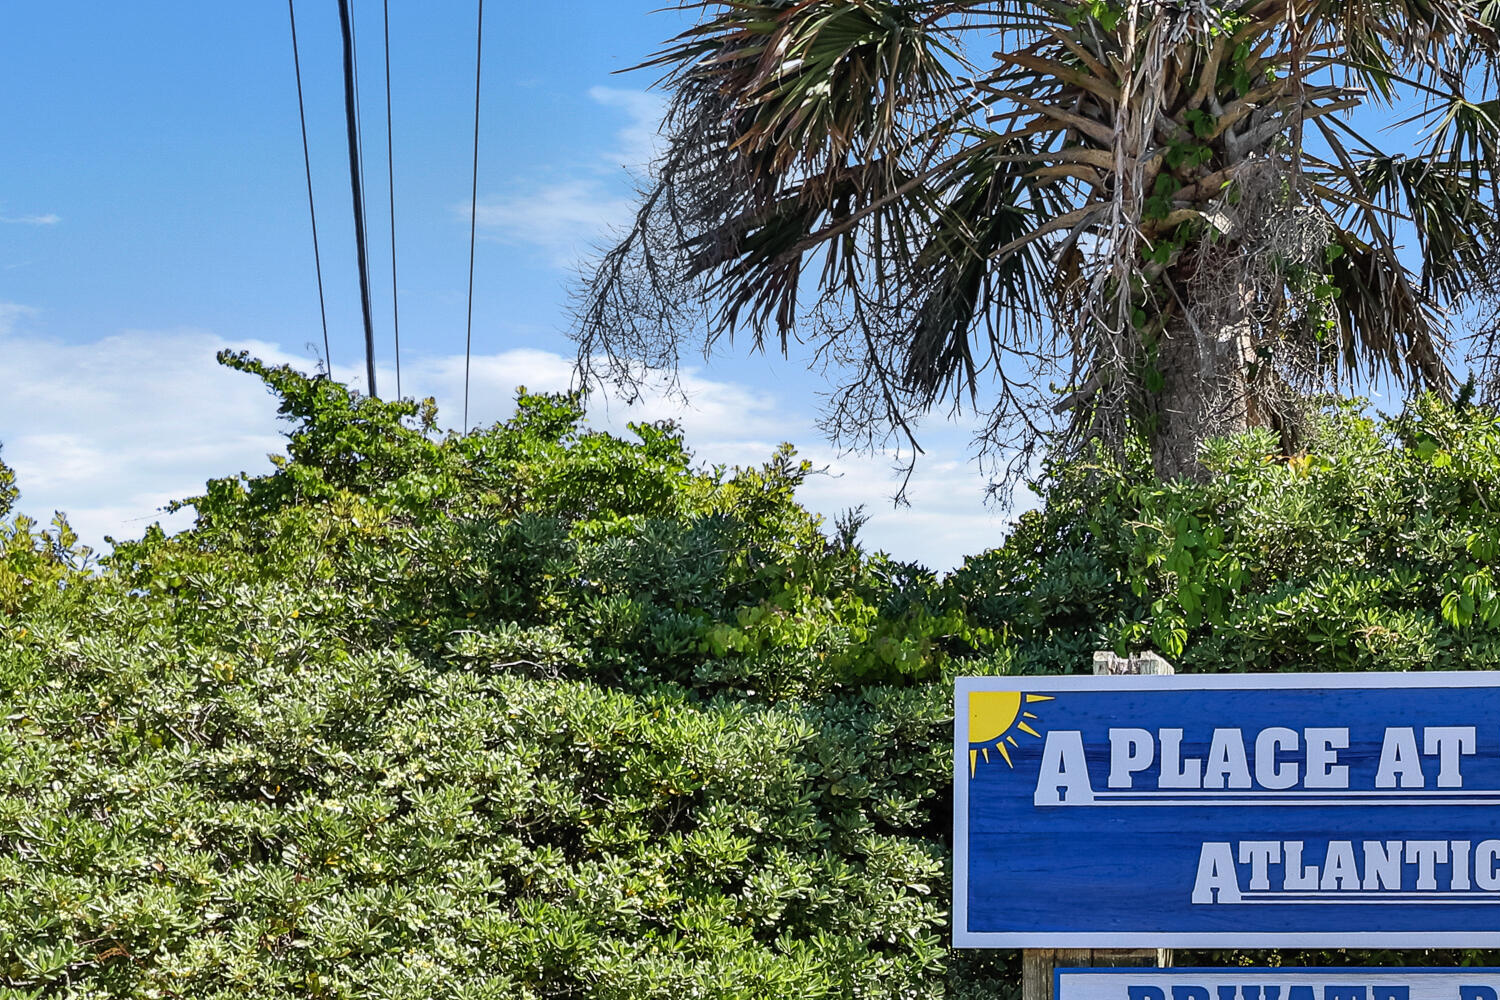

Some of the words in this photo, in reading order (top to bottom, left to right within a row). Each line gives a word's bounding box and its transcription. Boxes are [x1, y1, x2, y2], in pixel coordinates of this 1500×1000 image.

[1033, 730, 1095, 805] A
[1107, 726, 1351, 789] PLACE
[1374, 725, 1477, 788] AT
